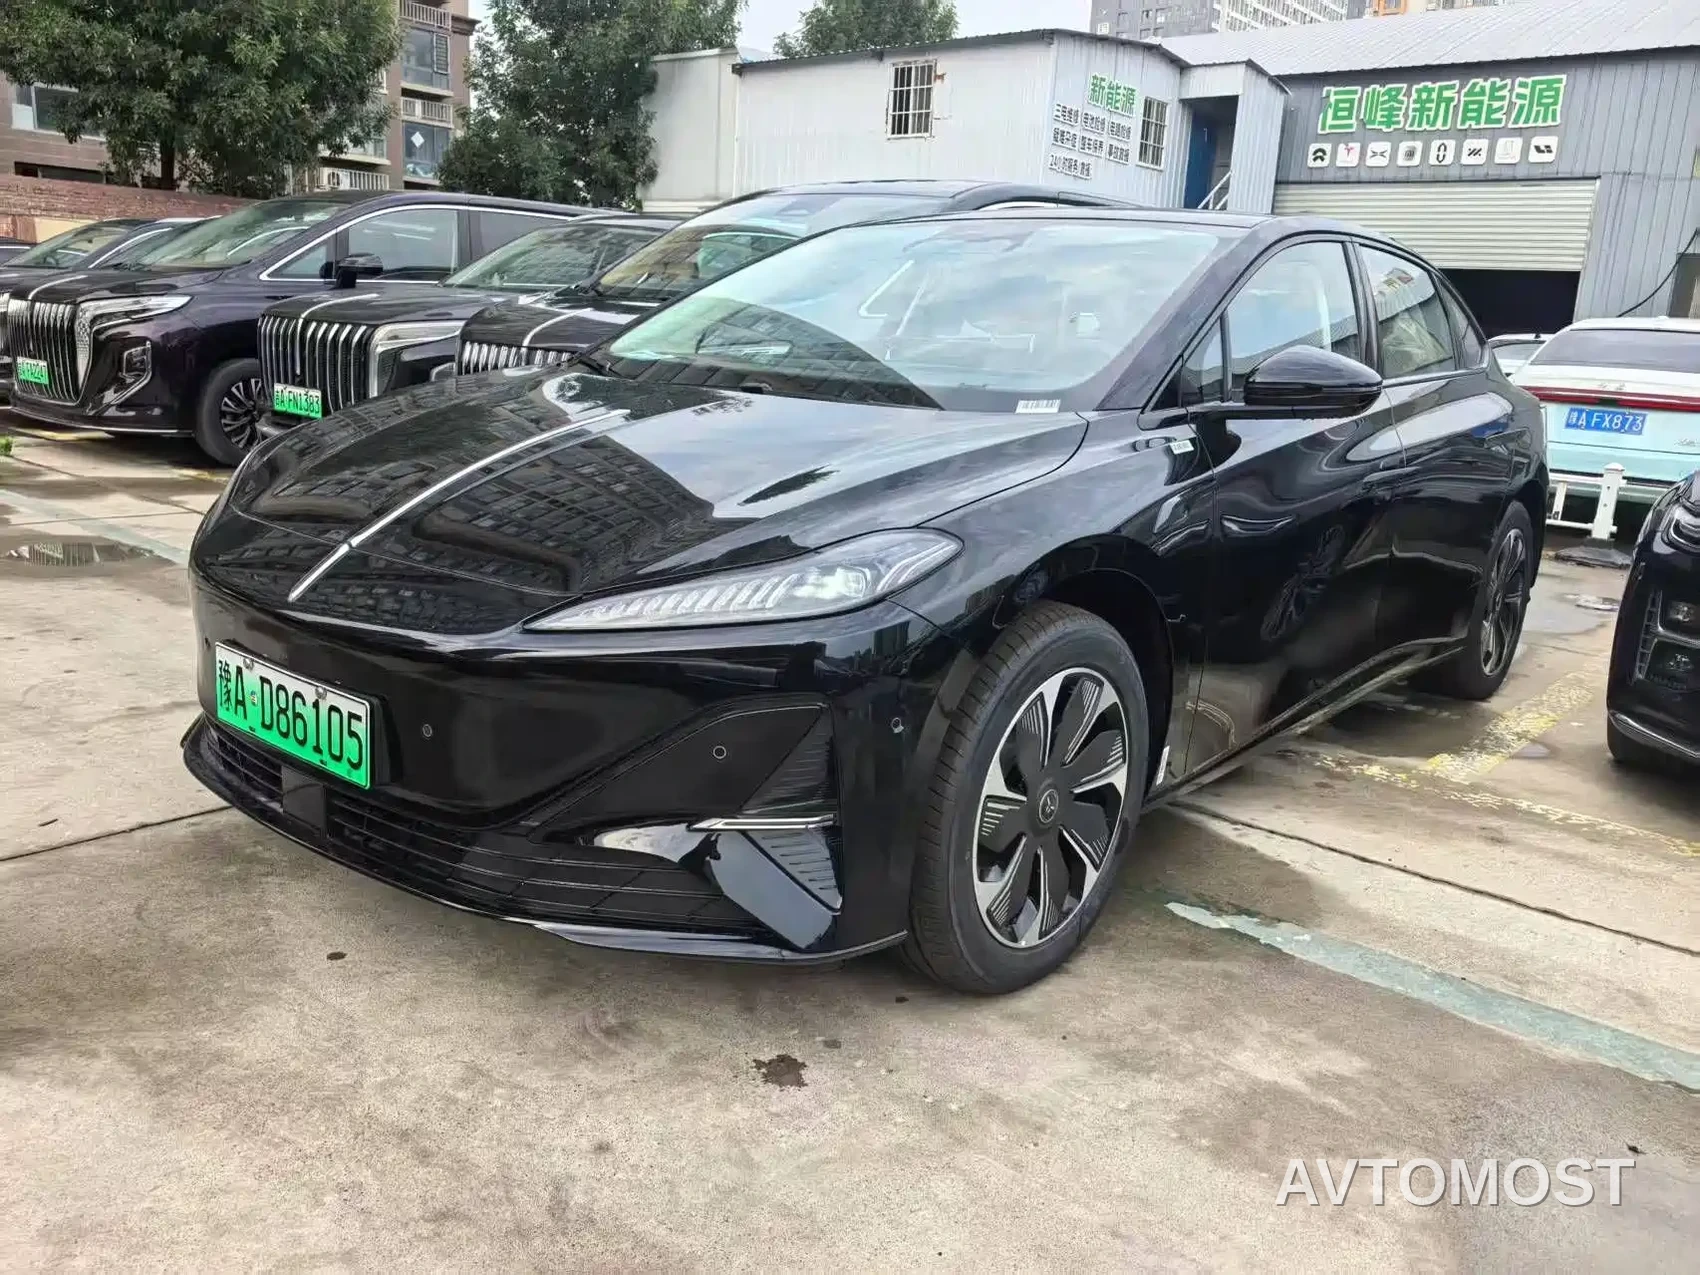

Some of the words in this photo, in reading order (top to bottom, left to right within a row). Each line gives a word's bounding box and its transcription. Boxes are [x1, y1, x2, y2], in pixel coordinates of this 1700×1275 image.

[1088, 74, 1136, 116] 新能源
[1319, 76, 1565, 133] 恒峰新能源
[1590, 412, 1643, 432] FX873
[218, 659, 248, 721] 豫A
[259, 675, 363, 771] D86105
